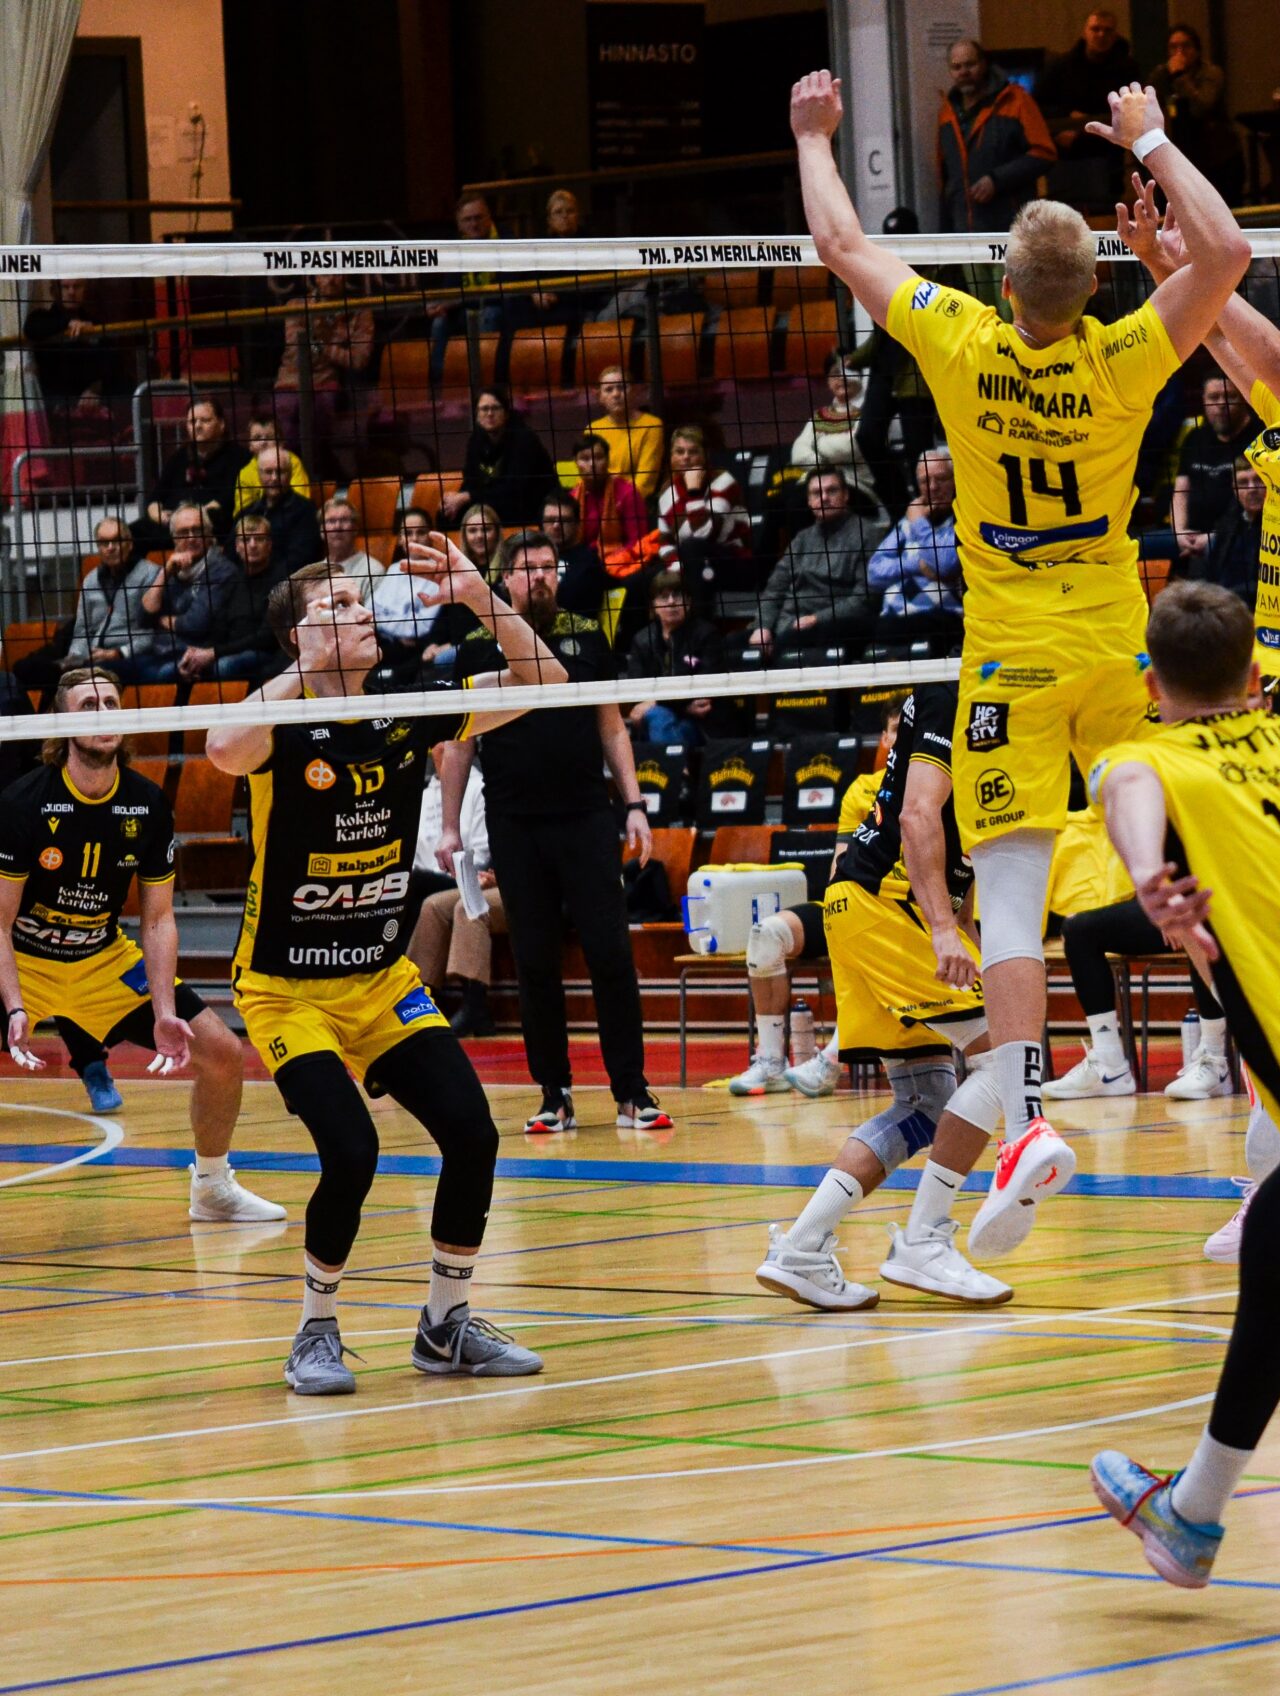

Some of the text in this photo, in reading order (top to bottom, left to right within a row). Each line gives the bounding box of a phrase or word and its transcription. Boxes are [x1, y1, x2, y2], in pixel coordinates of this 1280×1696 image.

[868, 150, 882, 176] C
[0, 254, 42, 273] INEN
[263, 245, 439, 270] TMI. PASI MERILÄINEN
[638, 242, 802, 265] TMI. PASI MERILÄINEN
[997, 452, 1083, 527] 14
[346, 757, 386, 797] 15
[980, 774, 1010, 806] BE
[114, 805, 149, 816] BOLIDEN
[335, 807, 392, 828] Kokkola
[975, 809, 1026, 830] BE GROUP
[336, 823, 388, 842] Karleby
[81, 842, 101, 878] 11
[56, 894, 103, 912] Karleby
[58, 885, 109, 903] Kokkola
[292, 871, 410, 911] CABB
[311, 912, 346, 922] PARTNER
[15, 916, 108, 946] CABB
[288, 940, 385, 965] umicore
[268, 1035, 288, 1062] 15
